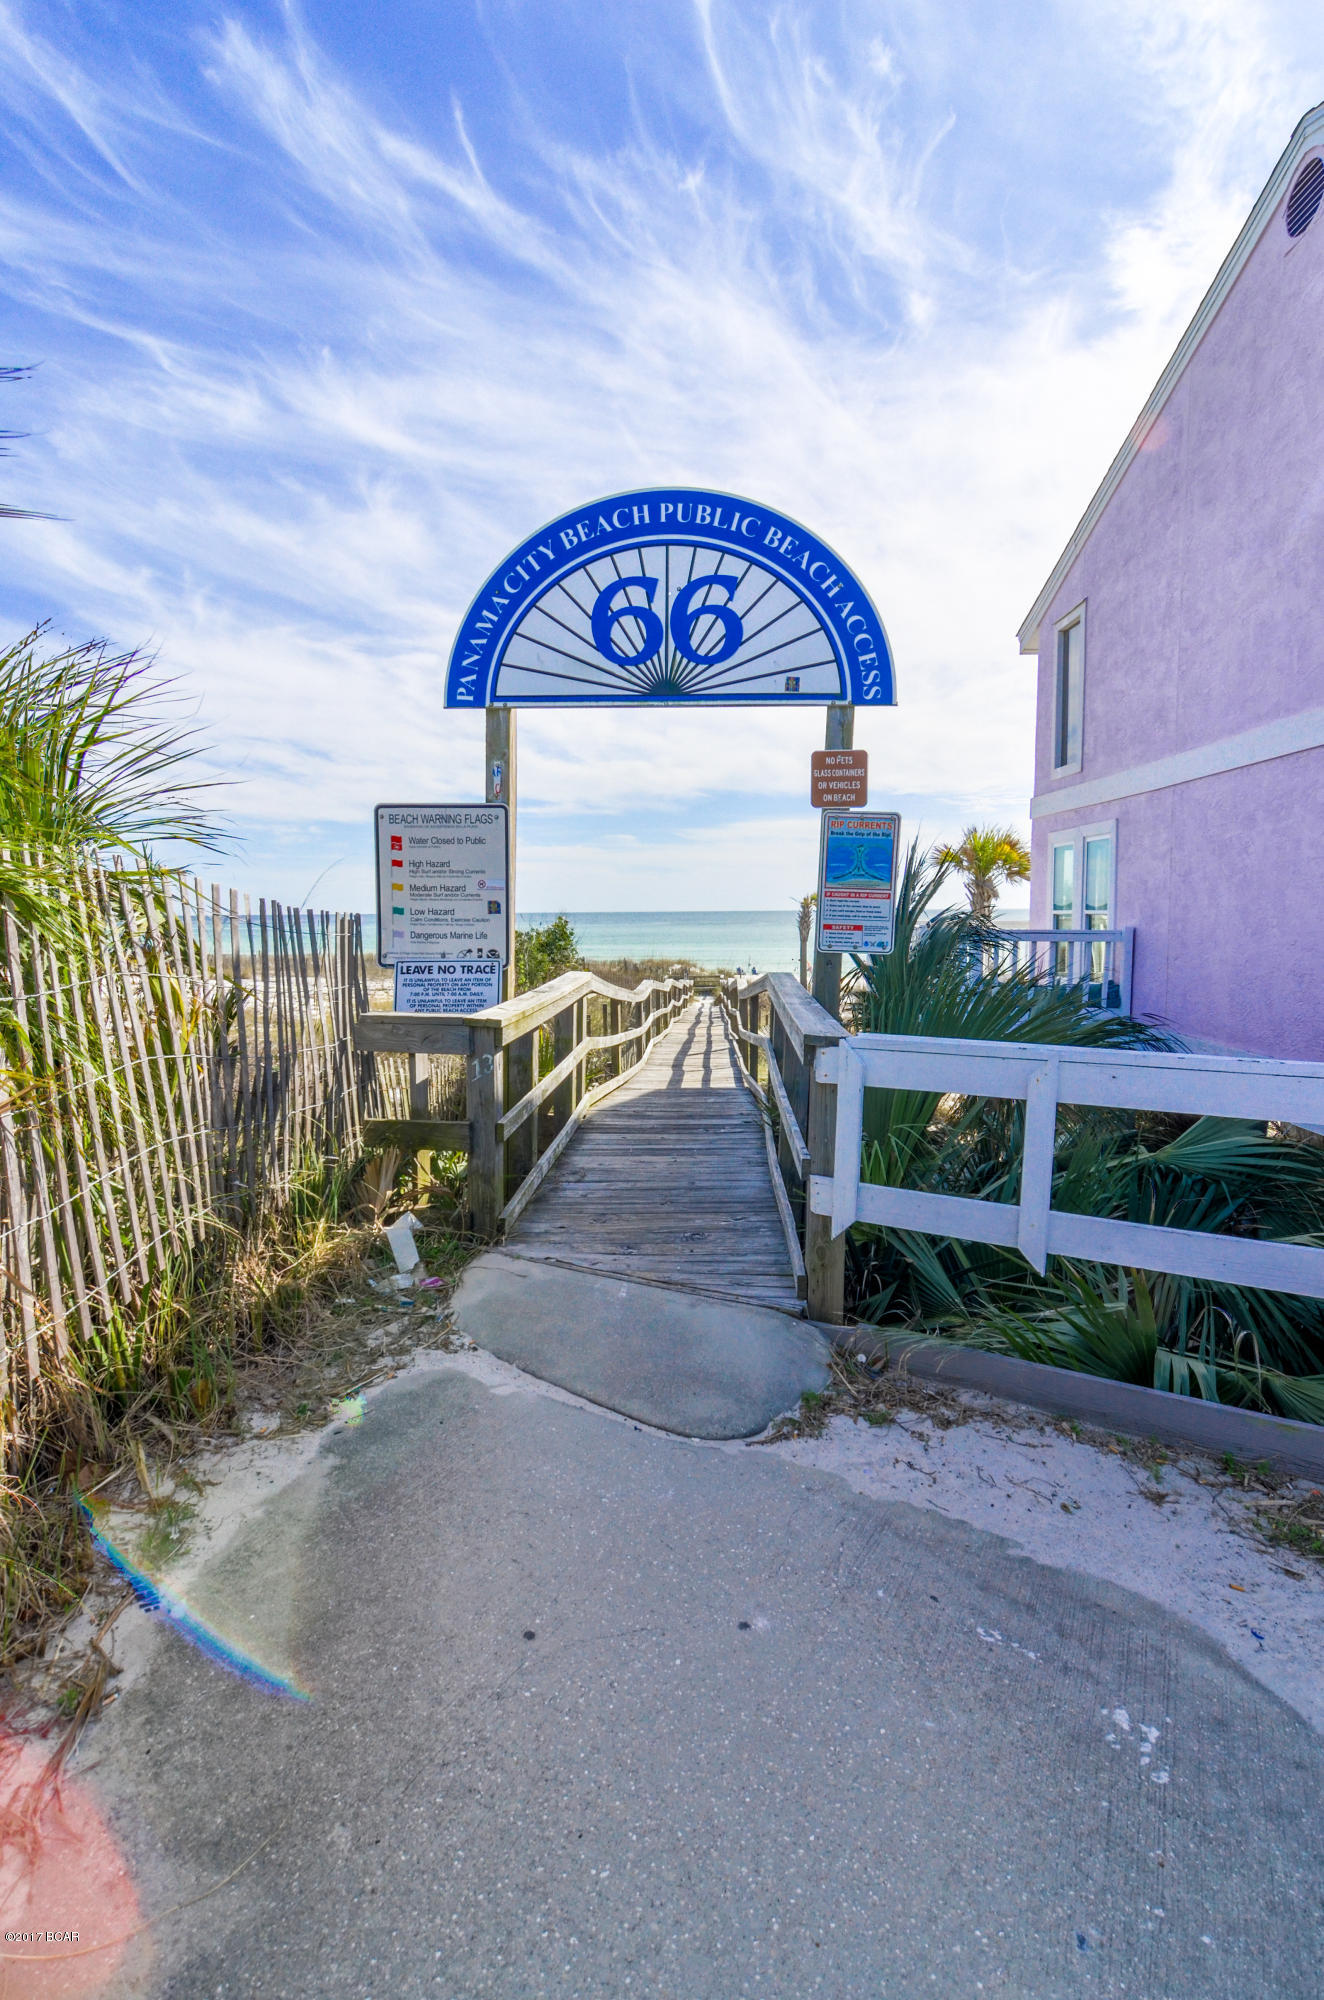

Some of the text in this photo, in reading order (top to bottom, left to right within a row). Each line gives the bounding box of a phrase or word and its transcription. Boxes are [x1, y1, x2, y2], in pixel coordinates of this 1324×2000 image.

[456, 502, 882, 702] PANAMA CITY BEACH PUBLIC BEACH ACCESS
[591, 574, 744, 667] 66
[826, 756, 853, 764] NO PETS
[818, 781, 860, 789] OR VEHICLES
[823, 794, 856, 802] ON BEACH
[388, 814, 494, 824] BEACH WARNING FLAGS
[848, 821, 892, 830] CURRENTS
[409, 836, 486, 845] Water Closed to Public
[409, 860, 450, 869] High Hazard
[409, 884, 466, 892] Medium Hazard
[410, 931, 448, 940] Dangerous
[450, 931, 473, 939] Marine
[400, 966, 496, 974] LEAVE NO TRACE
